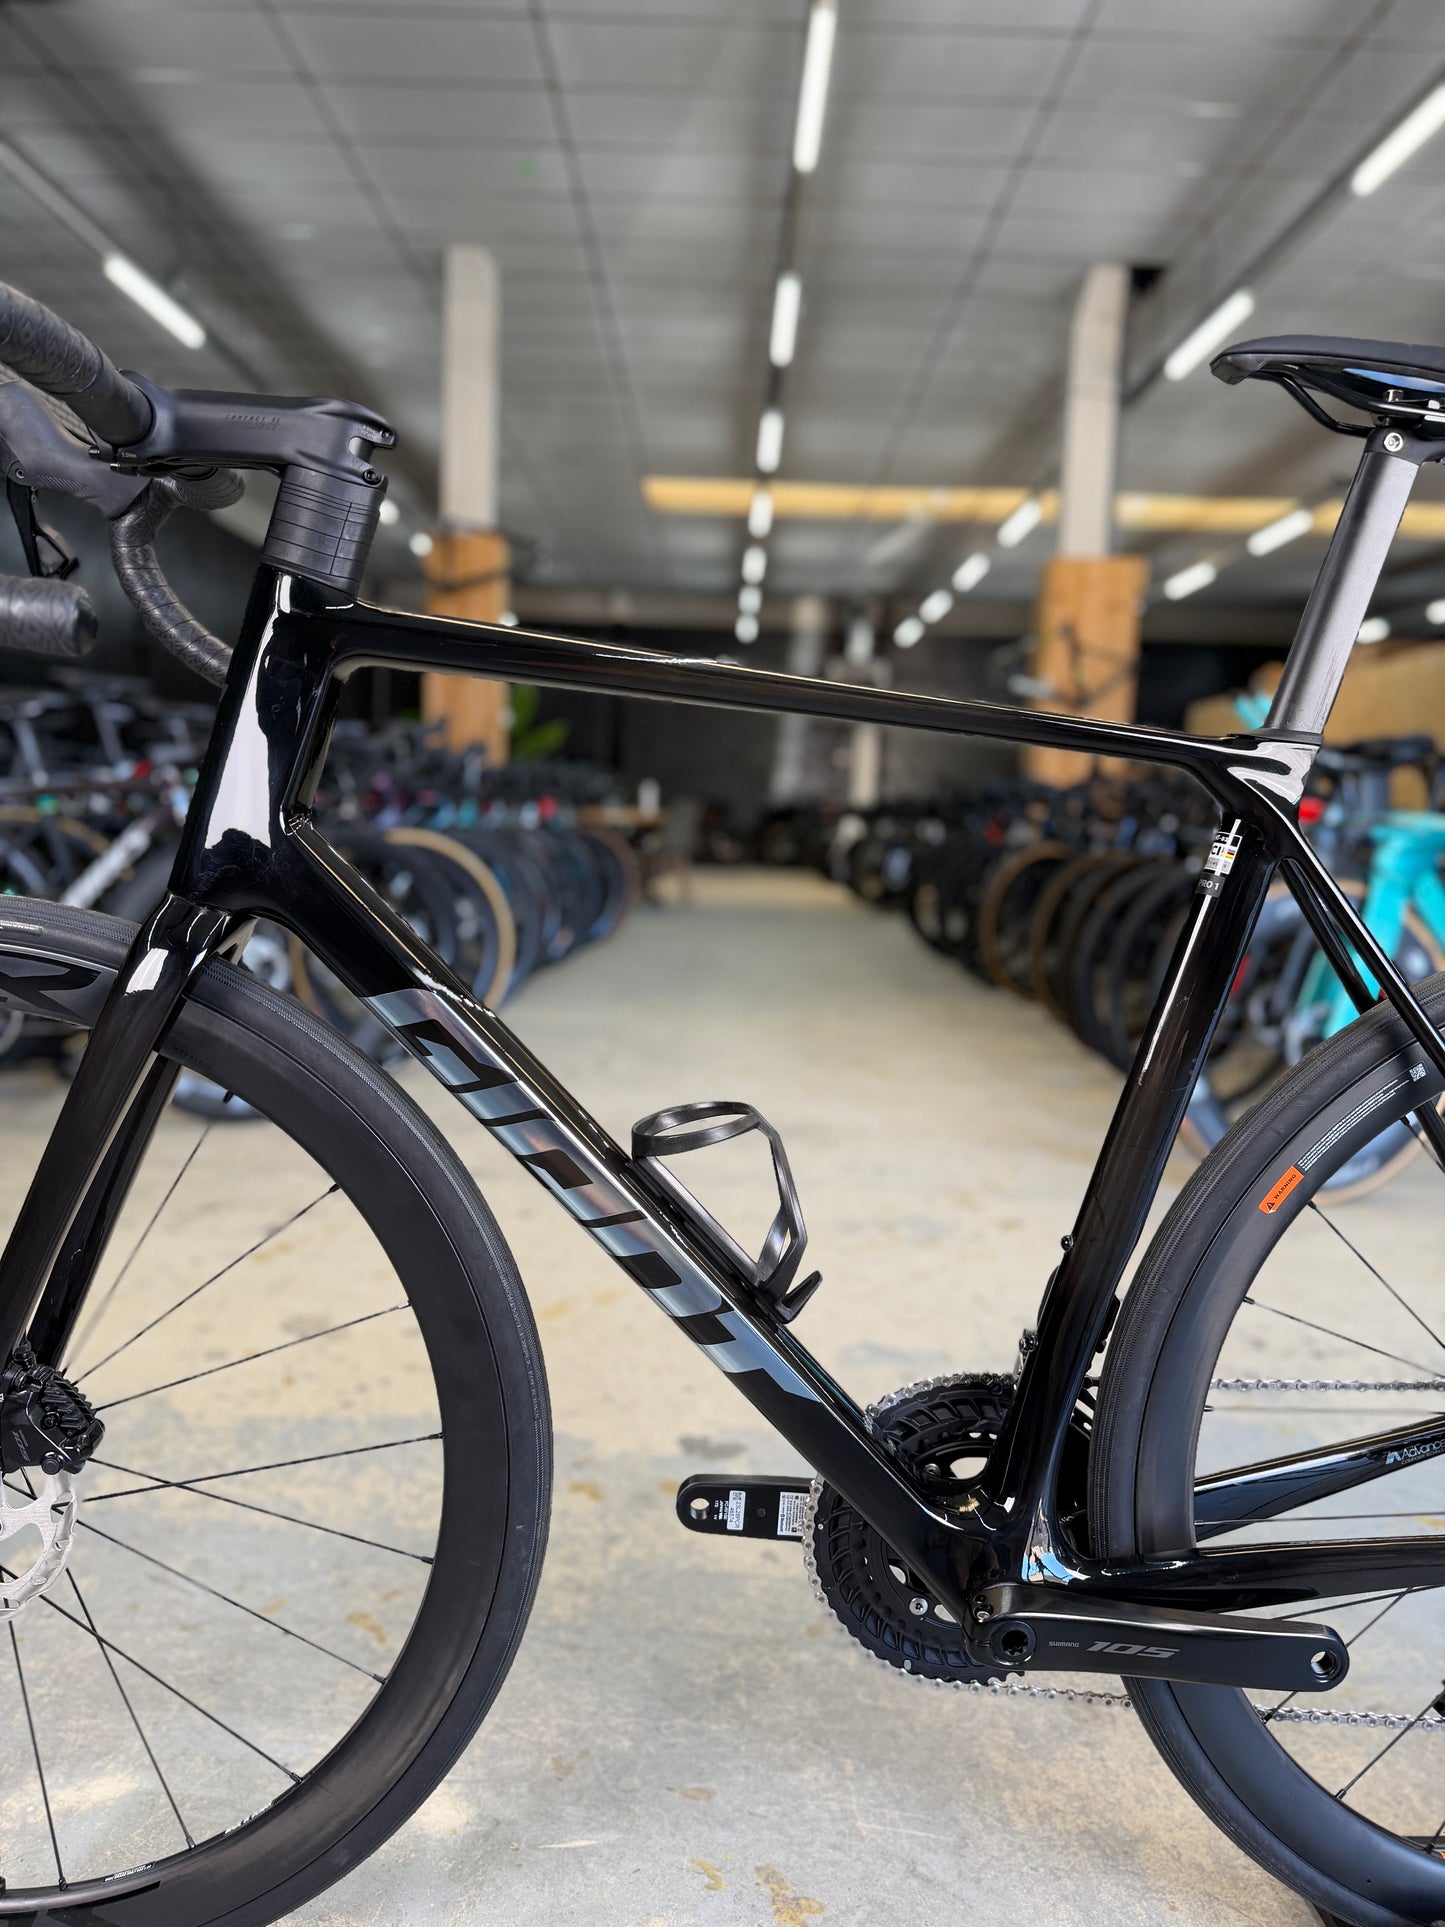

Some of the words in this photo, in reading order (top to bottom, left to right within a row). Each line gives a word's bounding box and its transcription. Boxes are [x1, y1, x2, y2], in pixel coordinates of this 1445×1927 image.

[361, 987, 823, 1405] GIANT
[1273, 1173, 1298, 1200] WARNING
[1048, 1640, 1080, 1648] SHIMANO
[1085, 1640, 1182, 1659] 105
